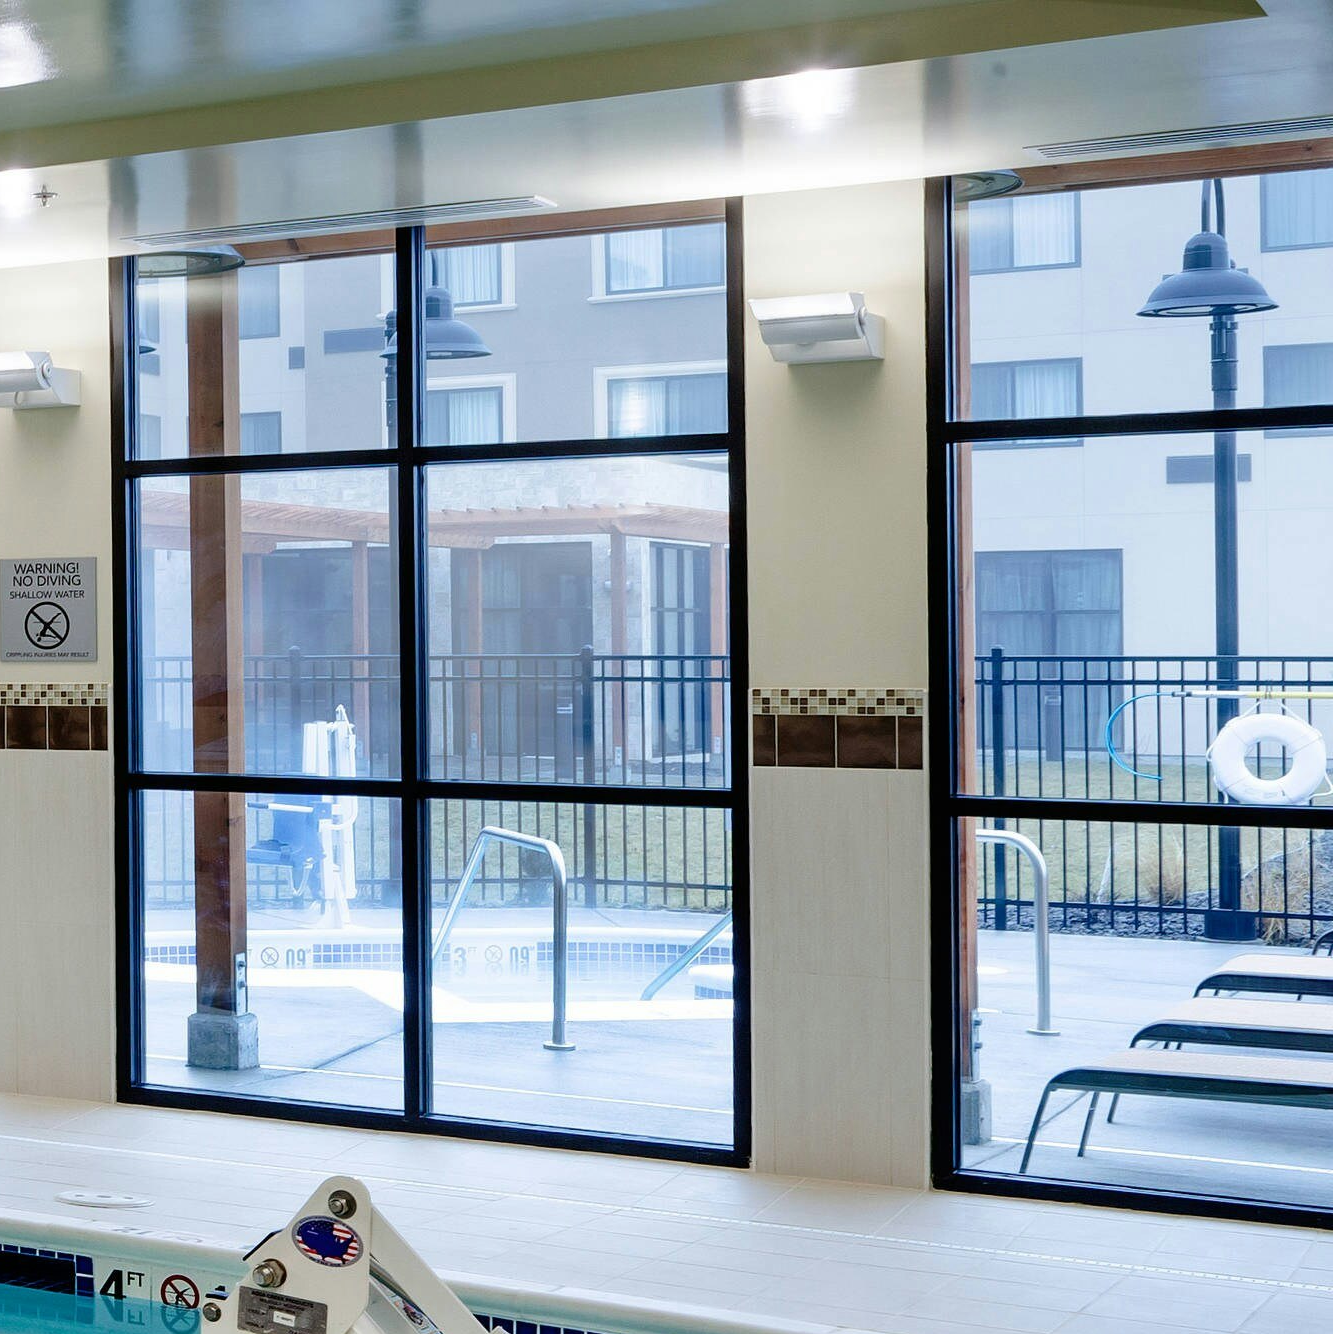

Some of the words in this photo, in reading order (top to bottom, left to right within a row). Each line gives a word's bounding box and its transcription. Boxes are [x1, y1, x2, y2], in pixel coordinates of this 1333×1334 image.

[14, 562, 79, 574] WARNING!
[13, 575, 33, 587] NO
[37, 575, 81, 587] DIVING
[9, 590, 53, 600] SHALLOW
[55, 590, 85, 599] WATER
[127, 1271, 145, 1287] FT
